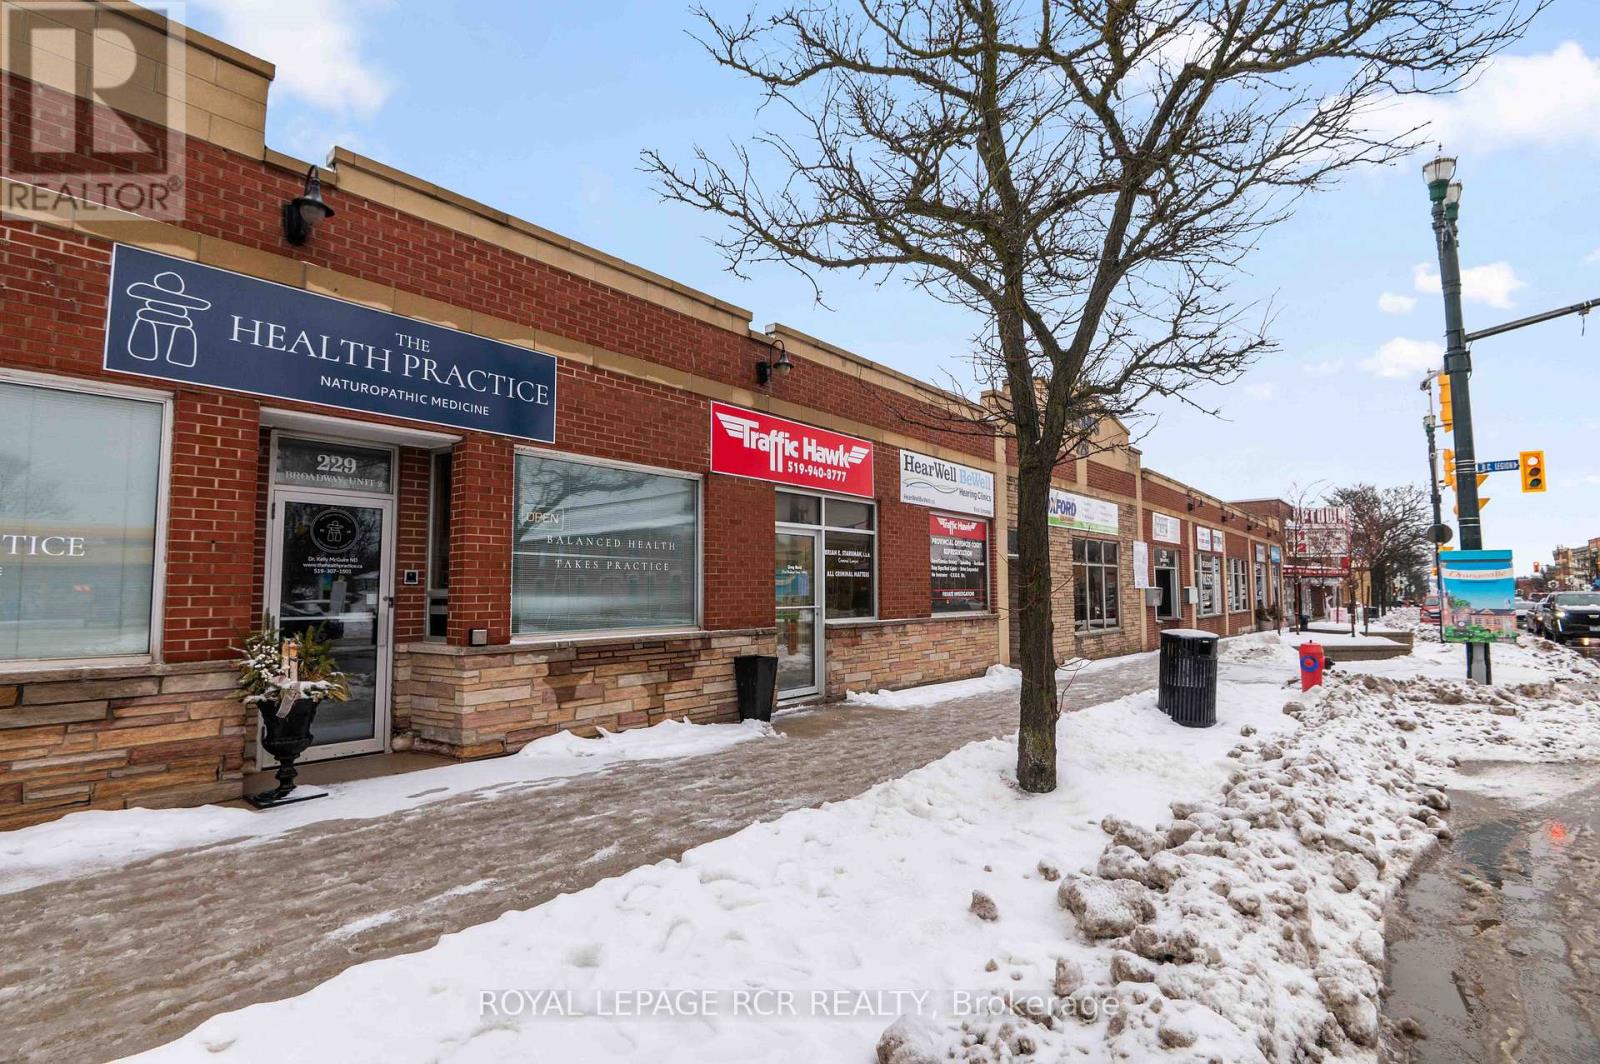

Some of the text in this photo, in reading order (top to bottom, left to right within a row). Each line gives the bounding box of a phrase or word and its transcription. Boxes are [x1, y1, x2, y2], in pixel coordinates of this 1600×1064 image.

[395, 332, 431, 352] THE
[229, 315, 549, 405] HEALTH PRACTICE
[321, 375, 490, 416] NATUROPATHIC MEDICINE
[715, 412, 851, 473] Traffic Hawk
[316, 454, 357, 474] 229
[788, 462, 846, 482] 519-940-8777
[903, 454, 991, 490] HearWell BeWell
[349, 477, 375, 486] UNIT
[1047, 497, 1076, 516] XFORD
[526, 512, 560, 524] OPEN
[2, 534, 85, 557] TICE
[547, 535, 675, 550] BALANCED HEALTH
[554, 560, 669, 571] TAKES PRACTICE
